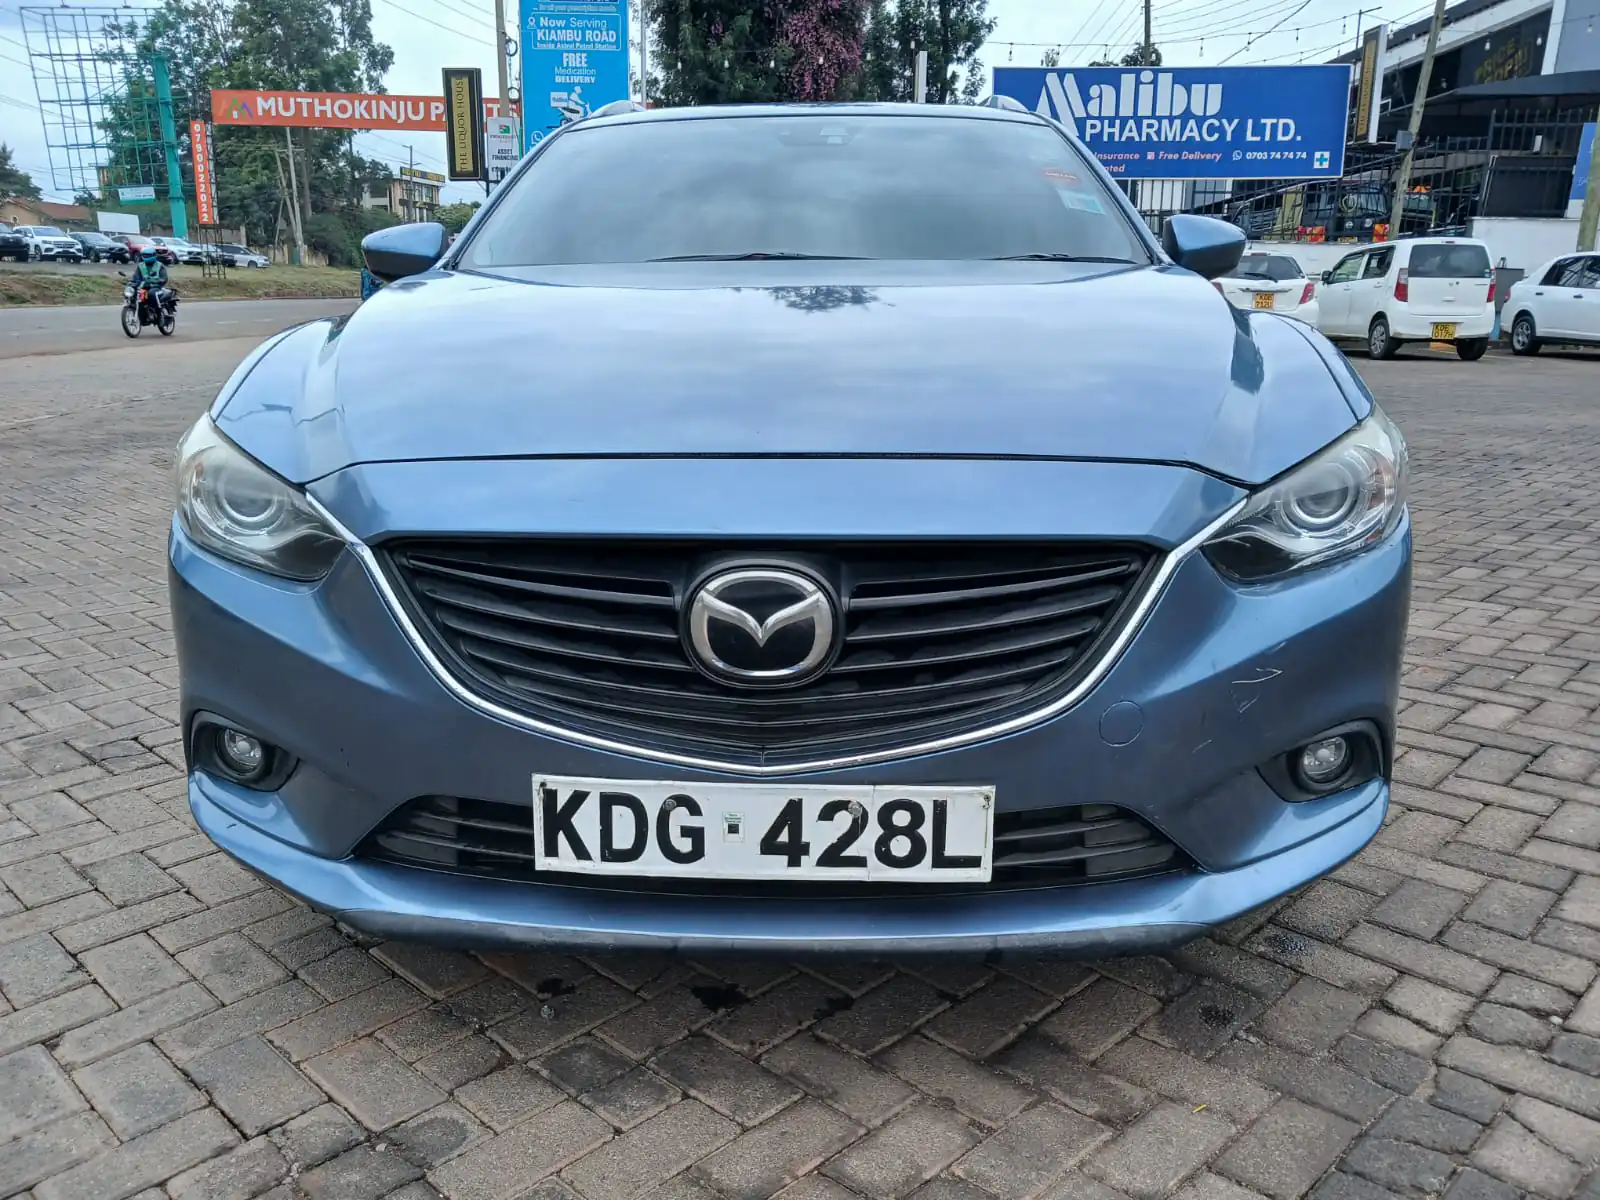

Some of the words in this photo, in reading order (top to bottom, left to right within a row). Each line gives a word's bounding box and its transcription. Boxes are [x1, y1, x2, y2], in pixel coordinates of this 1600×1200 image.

[540, 17, 566, 27] Now
[570, 17, 607, 30] Serving
[537, 29, 581, 41] KIAMBU
[585, 30, 616, 42] ROAD
[562, 52, 588, 67] FREE
[555, 66, 596, 75] Medication
[555, 75, 596, 83] DELIVERY
[257, 96, 424, 124] MUTHOKINJU
[1036, 70, 1223, 136] Malibu
[456, 112, 467, 149] LIQUOR
[1085, 118, 1240, 143] PHARMACY
[1246, 117, 1302, 142] LTD.
[459, 152, 468, 172] THE
[1094, 152, 1140, 160] Insurance
[1158, 151, 1179, 160] Free
[1182, 151, 1222, 162] Delivery
[1246, 151, 1268, 160] 0703
[1295, 151, 1307, 160] 74
[542, 788, 706, 864] KDG
[759, 797, 983, 871] 428L
